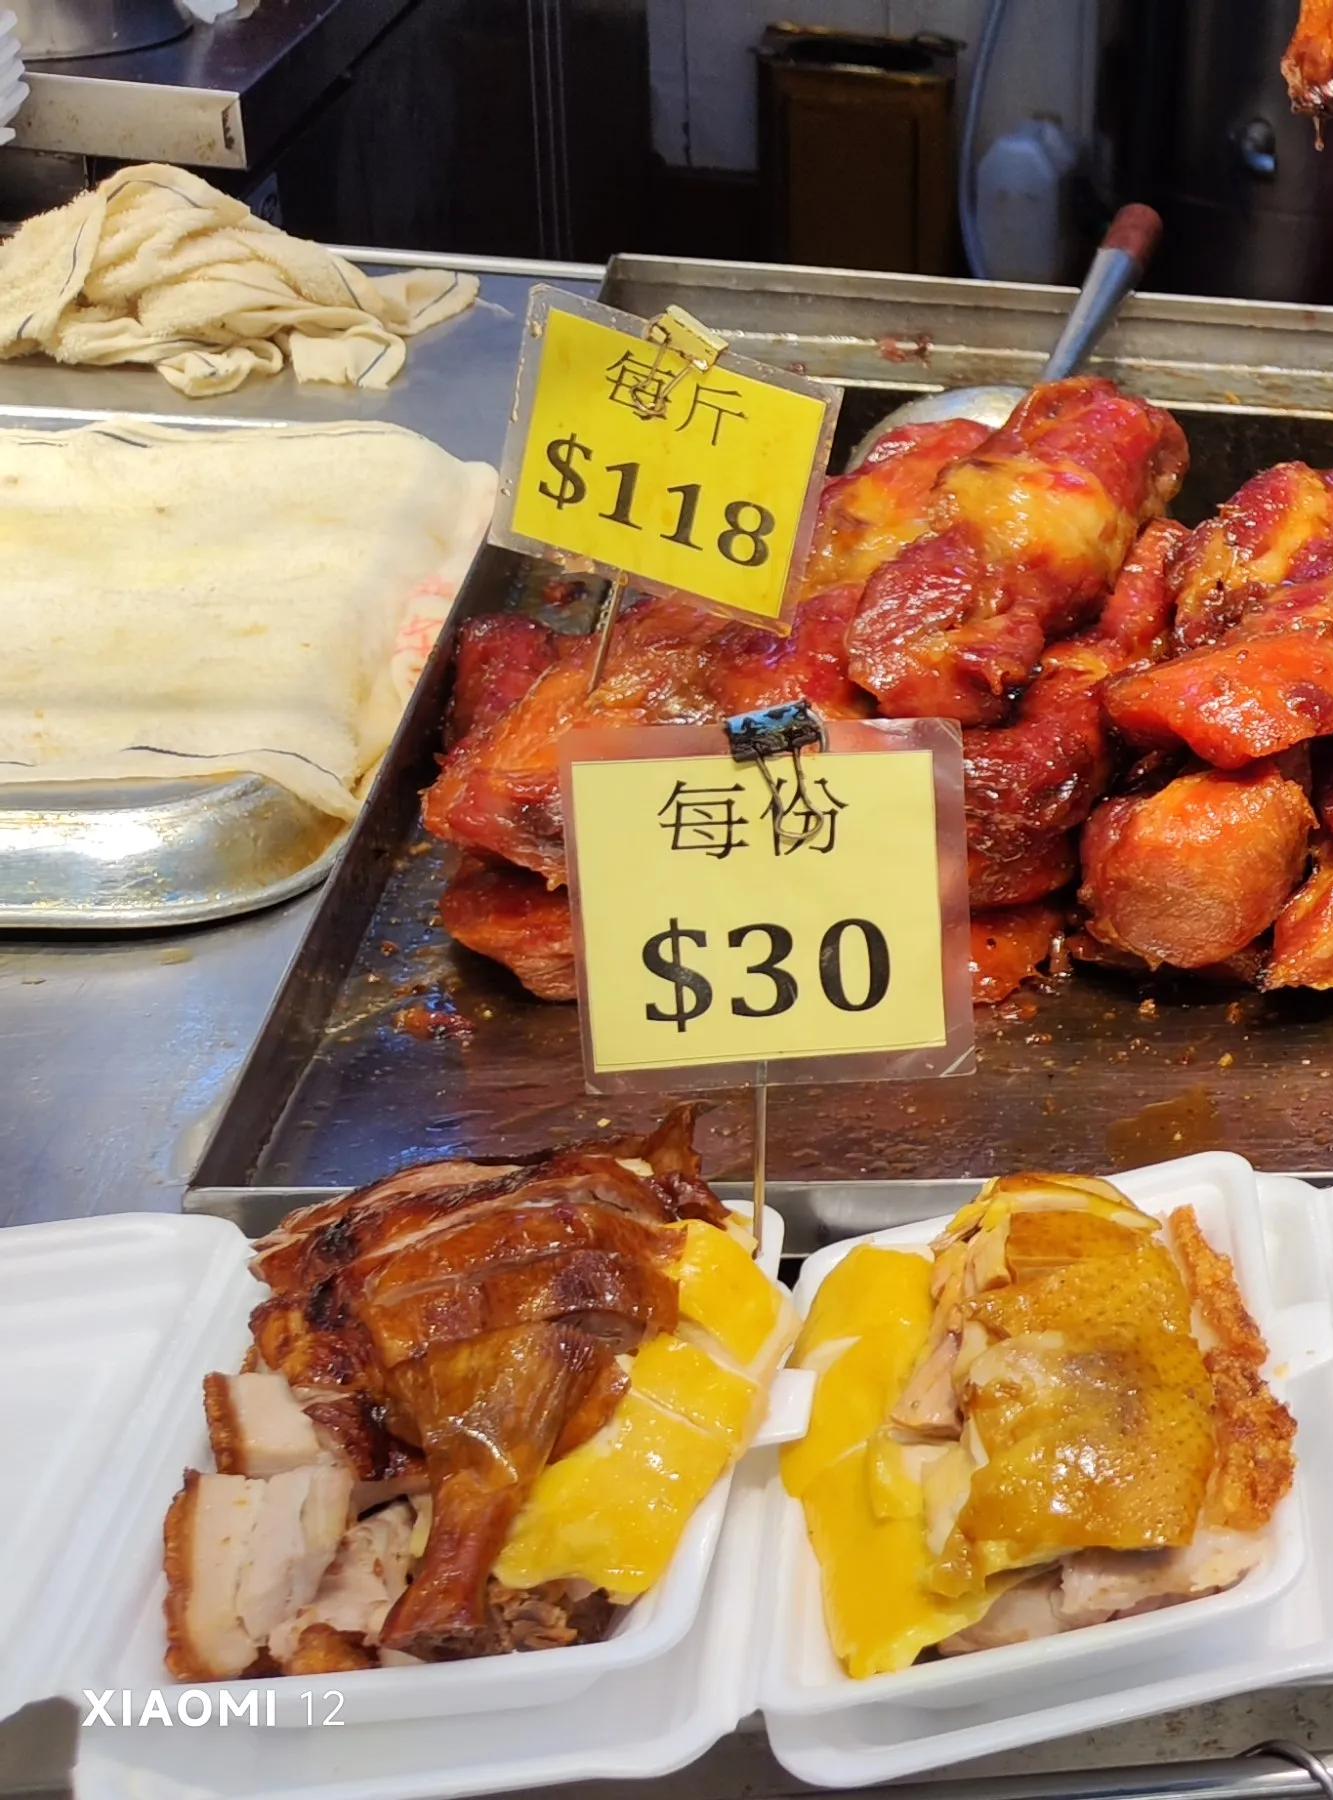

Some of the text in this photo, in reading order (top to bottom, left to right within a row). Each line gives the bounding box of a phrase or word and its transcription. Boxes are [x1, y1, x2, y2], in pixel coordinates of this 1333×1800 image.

[605, 349, 749, 447] 每斤
[538, 432, 776, 568] $118
[657, 777, 849, 860] 每份
[641, 917, 891, 1032] $30
